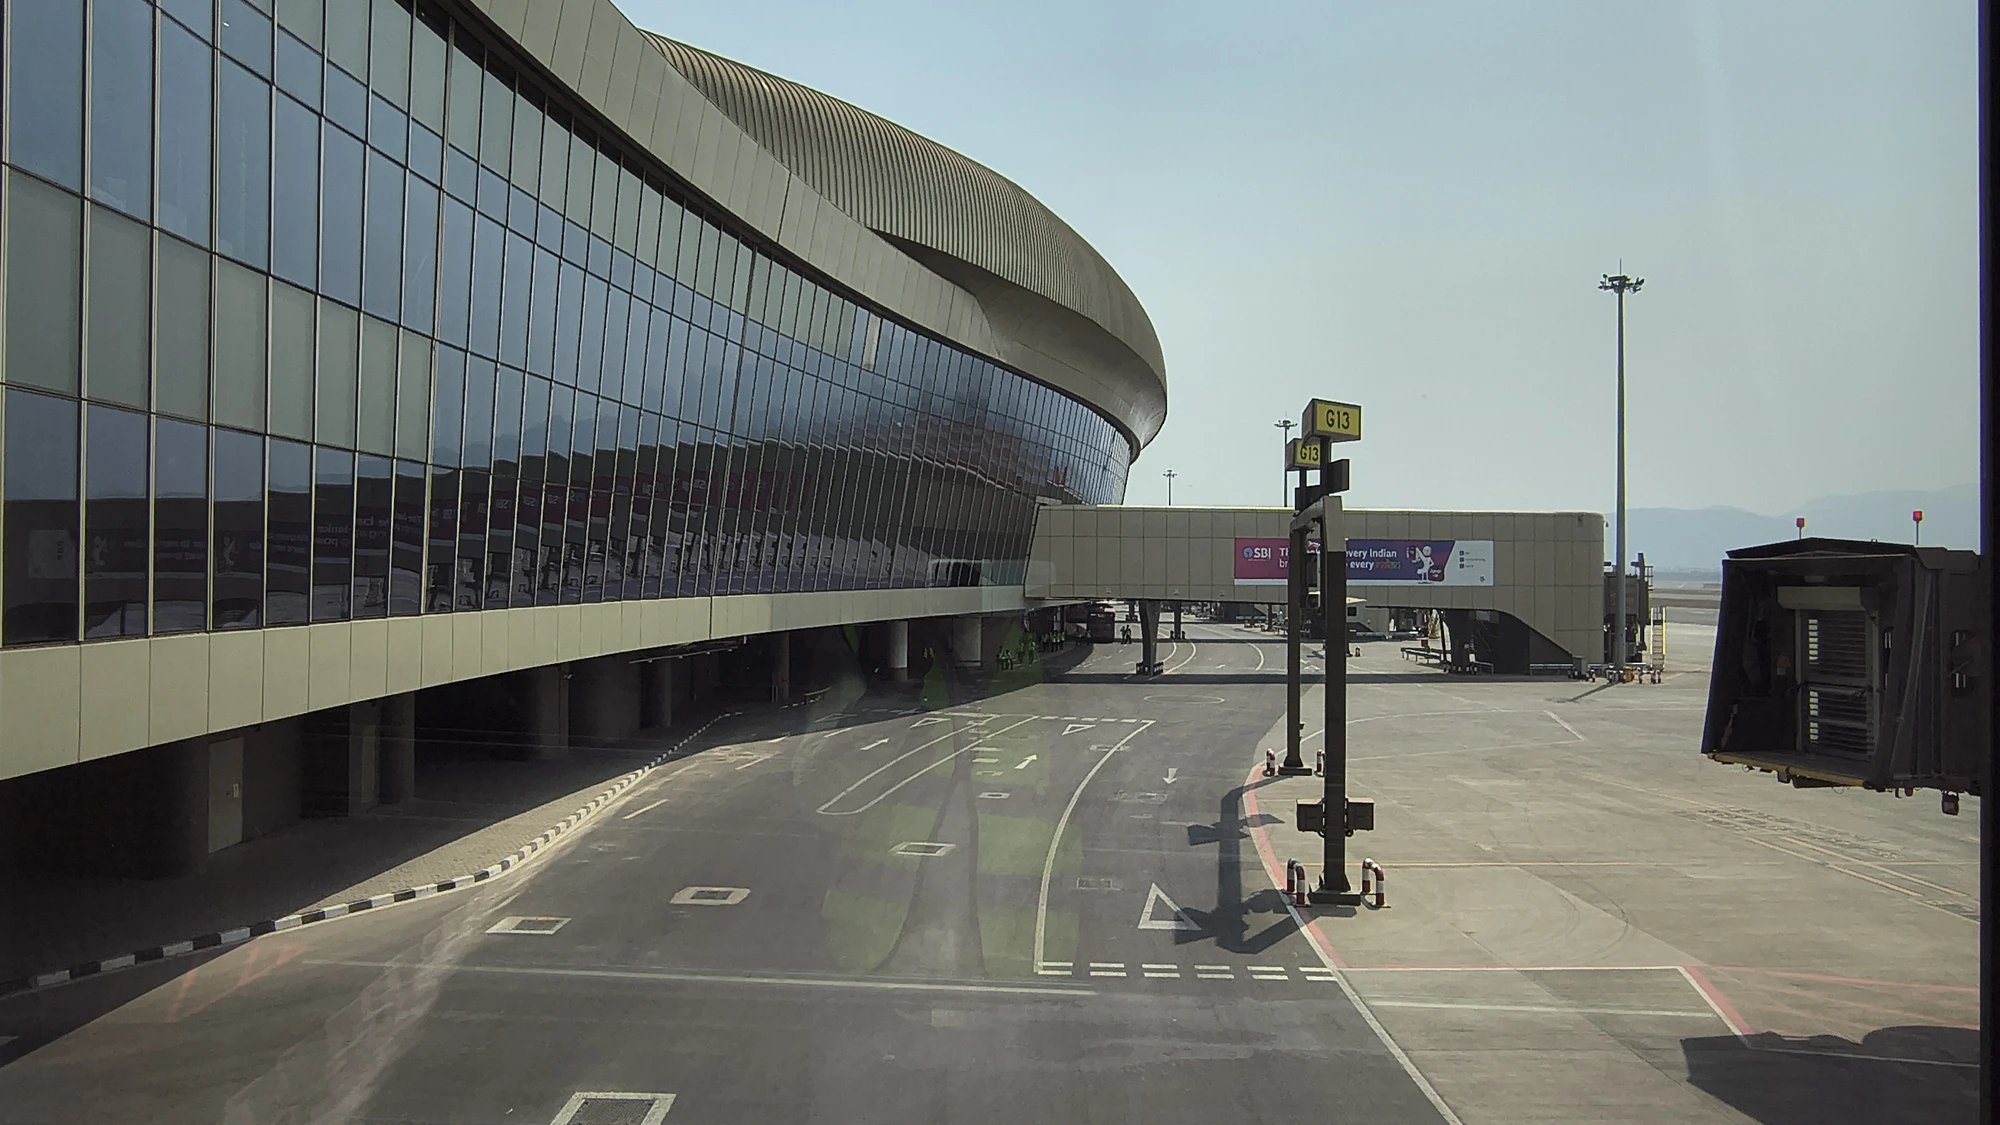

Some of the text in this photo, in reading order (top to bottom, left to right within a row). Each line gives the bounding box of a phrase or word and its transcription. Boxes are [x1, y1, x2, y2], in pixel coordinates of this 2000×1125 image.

[1326, 409, 1350, 429] G13
[1300, 446, 1319, 461] G13
[1253, 547, 1271, 559] SBI
[1369, 548, 1397, 558] Indian
[1350, 561, 1375, 571] every
